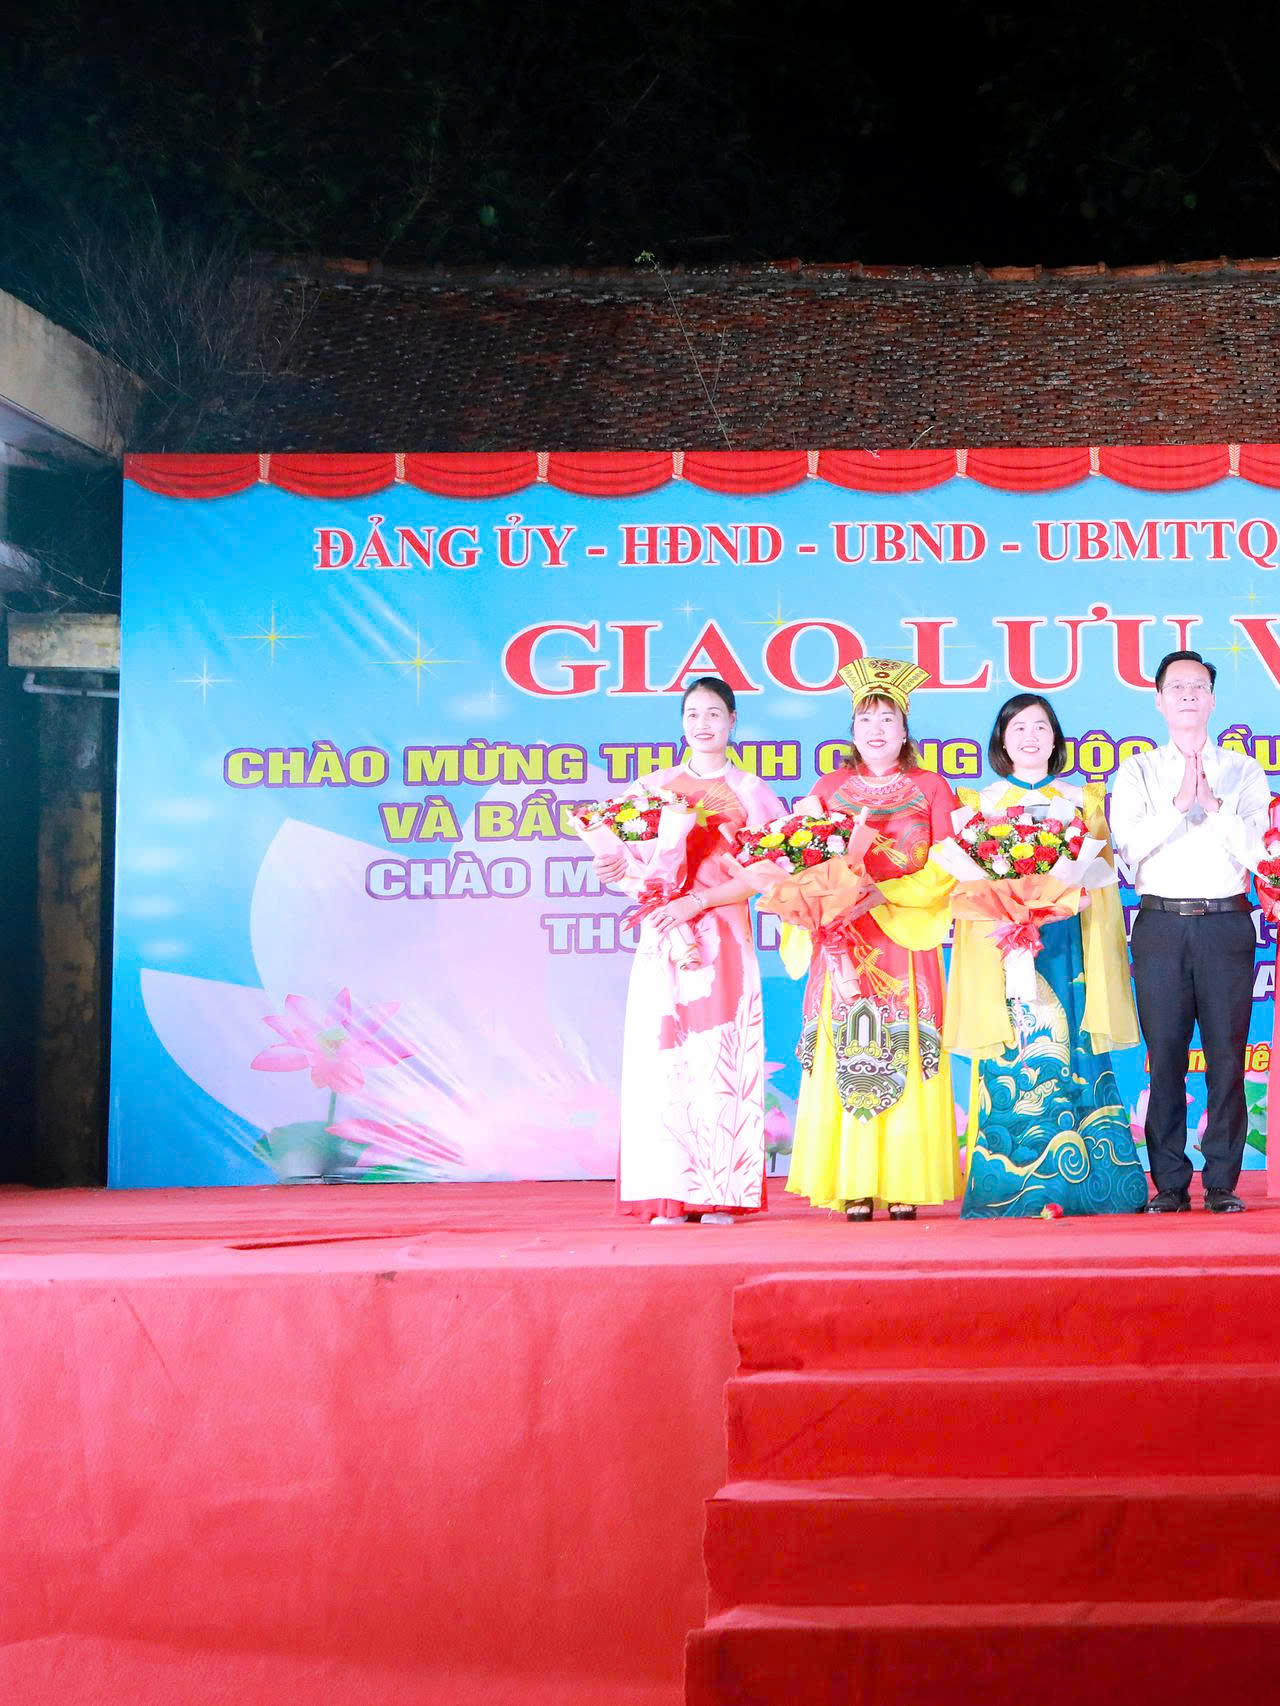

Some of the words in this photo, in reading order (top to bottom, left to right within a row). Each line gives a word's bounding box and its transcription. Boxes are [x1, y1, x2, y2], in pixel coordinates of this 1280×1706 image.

[315, 516, 480, 569] ĐẢNG
[496, 515, 573, 567] ỦY
[618, 523, 783, 567] HĐND
[831, 520, 986, 564] UBND
[1037, 518, 1279, 568] UBMTTQ
[502, 619, 868, 697] GIAO
[902, 606, 1204, 692] LƯU
[226, 741, 388, 787] CHÀO
[404, 739, 586, 783] MỪNG
[381, 796, 462, 841] VÀ
[367, 853, 530, 898] CHÀO
